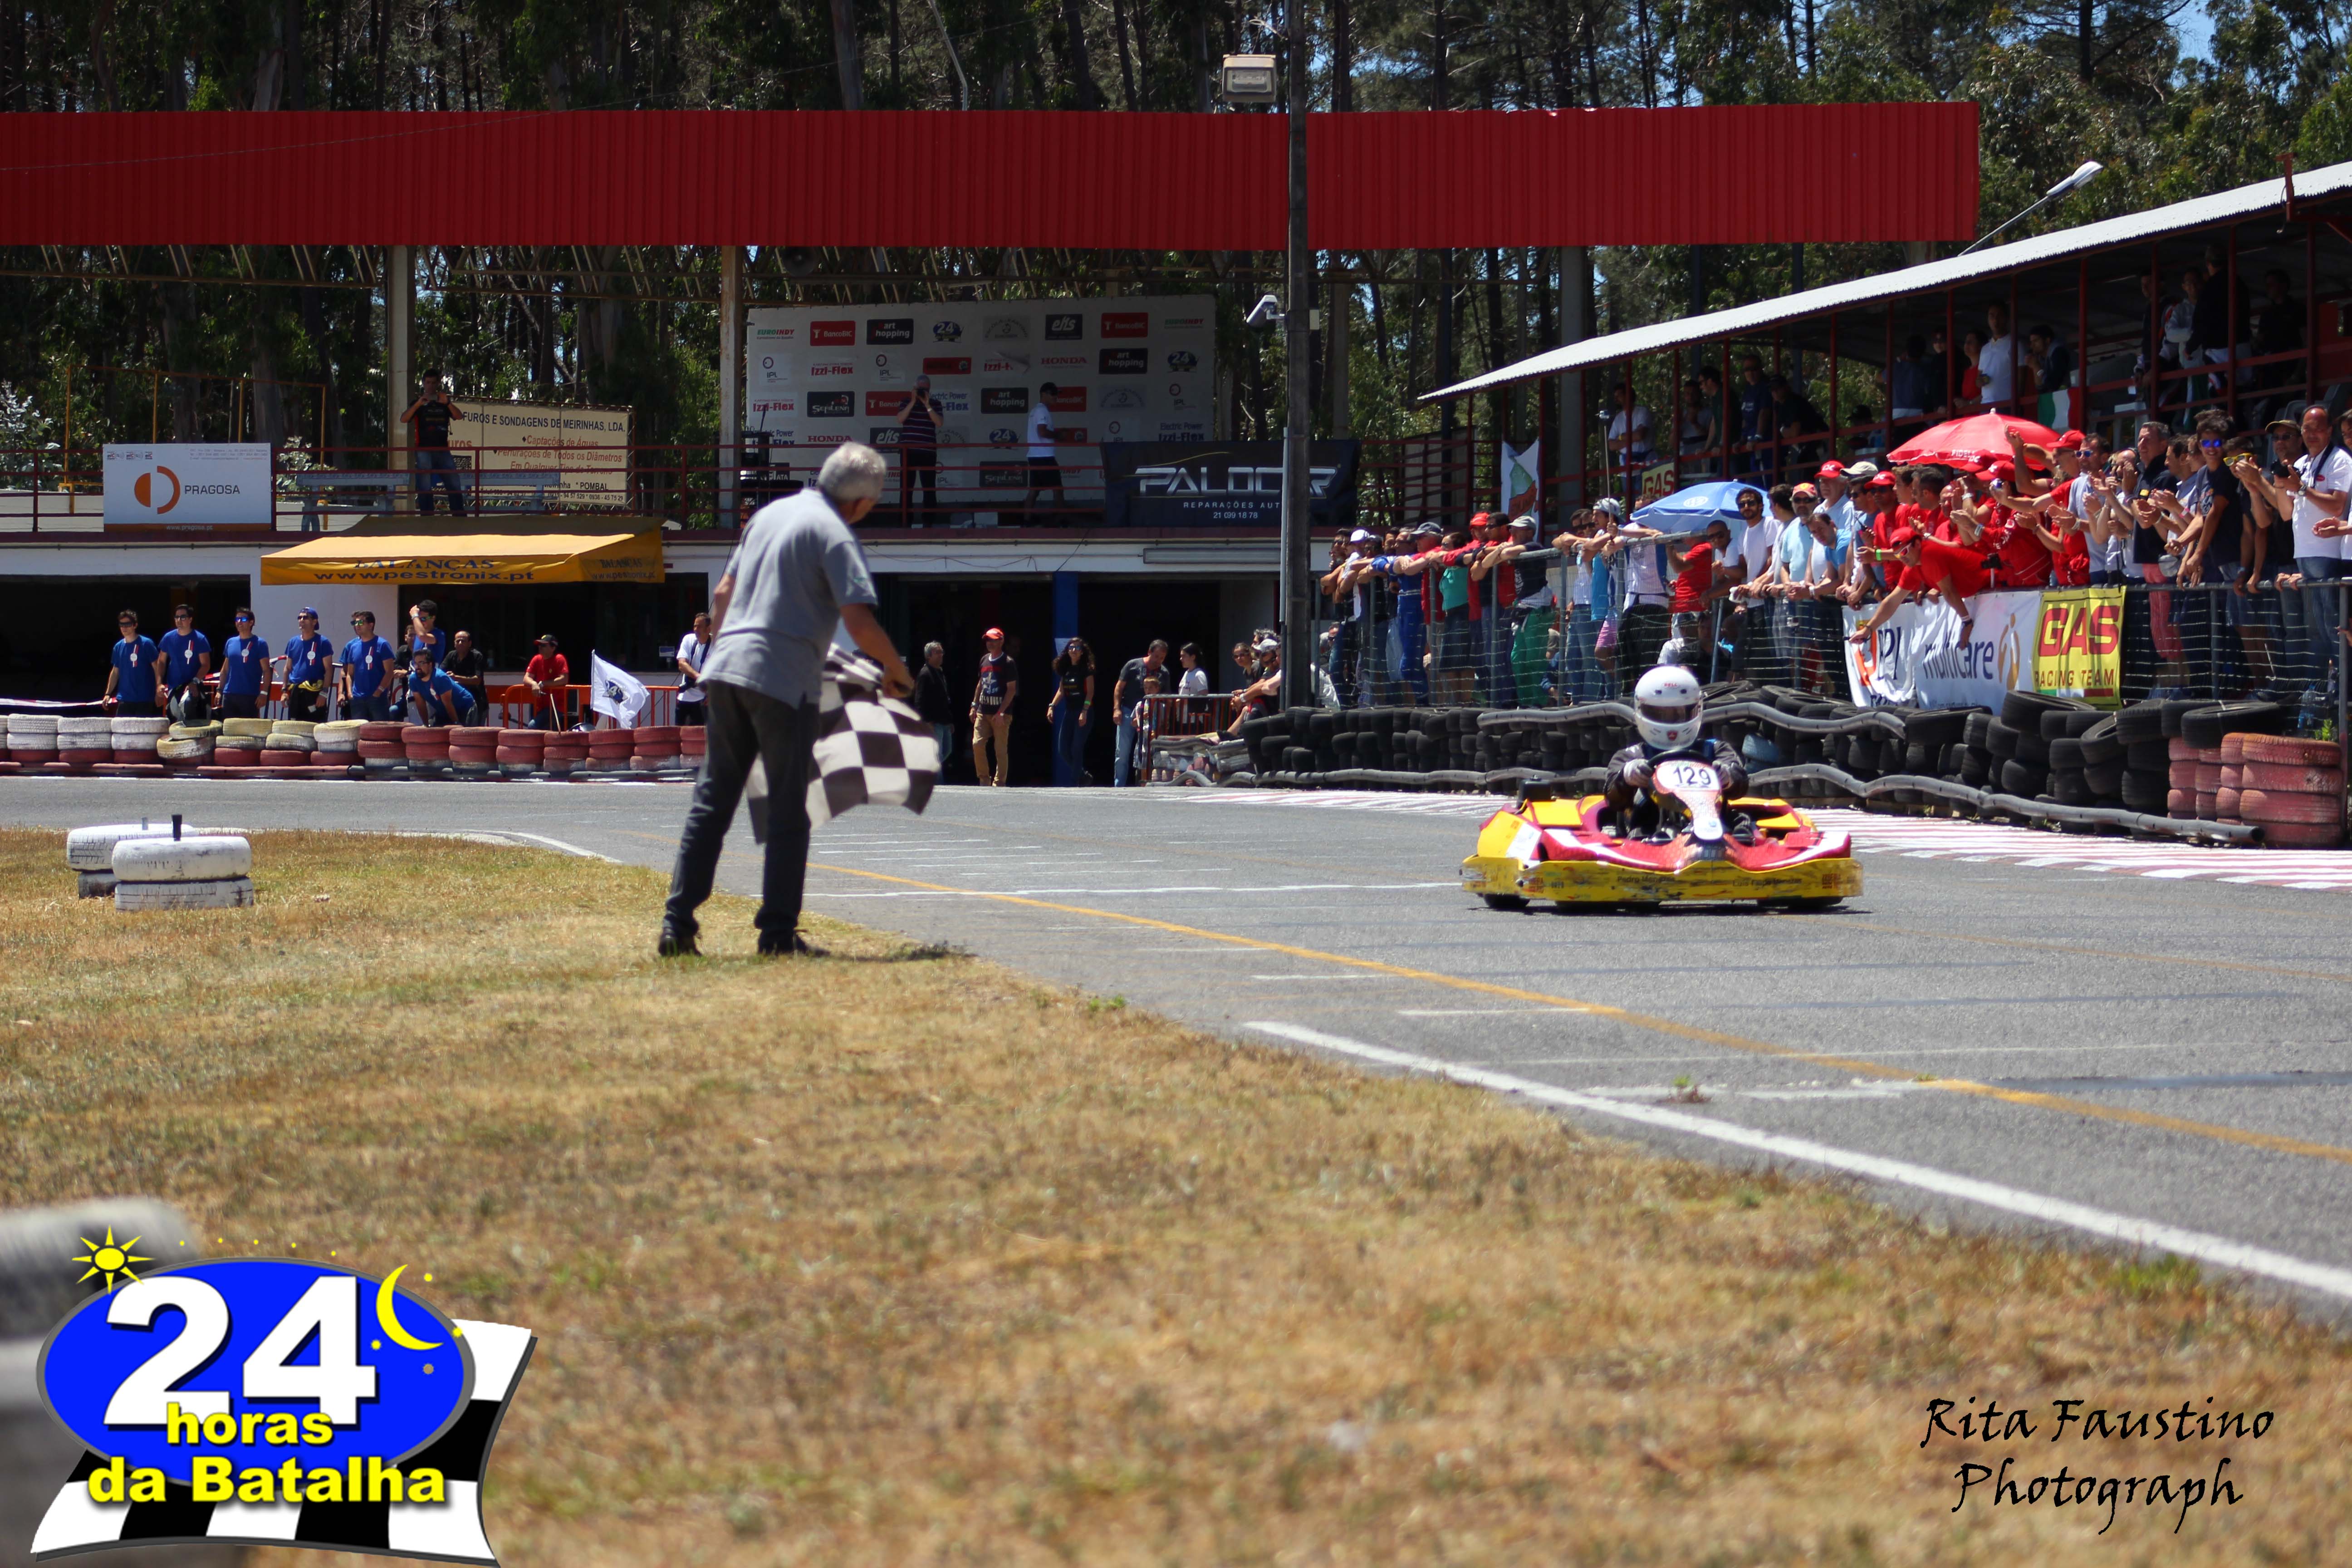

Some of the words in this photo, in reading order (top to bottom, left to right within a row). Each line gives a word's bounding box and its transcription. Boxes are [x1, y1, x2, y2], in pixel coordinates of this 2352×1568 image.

[811, 367, 853, 376] Izzi-Flex
[463, 412, 490, 424] FUROS
[492, 415, 497, 424] E
[499, 416, 548, 428] SONDAGENS
[551, 419, 561, 428] DE
[563, 419, 606, 432] MEIRINHAS,
[608, 422, 626, 432] LDA.
[448, 439, 472, 447] uros
[566, 438, 575, 446] de
[587, 451, 622, 462] Diâmetros
[580, 482, 609, 490] POMBAL
[1135, 466, 1337, 497] PALOCR
[1644, 470, 1674, 496] GAS
[184, 485, 240, 495] PRAGOSA
[1184, 500, 1254, 509] REPARAÇÕES
[314, 570, 534, 581] www.pestronix.pt
[2038, 605, 2121, 657] GAS
[2035, 670, 2075, 687] RACING
[2081, 668, 2114, 687] TEAM
[1673, 766, 1711, 785] 129
